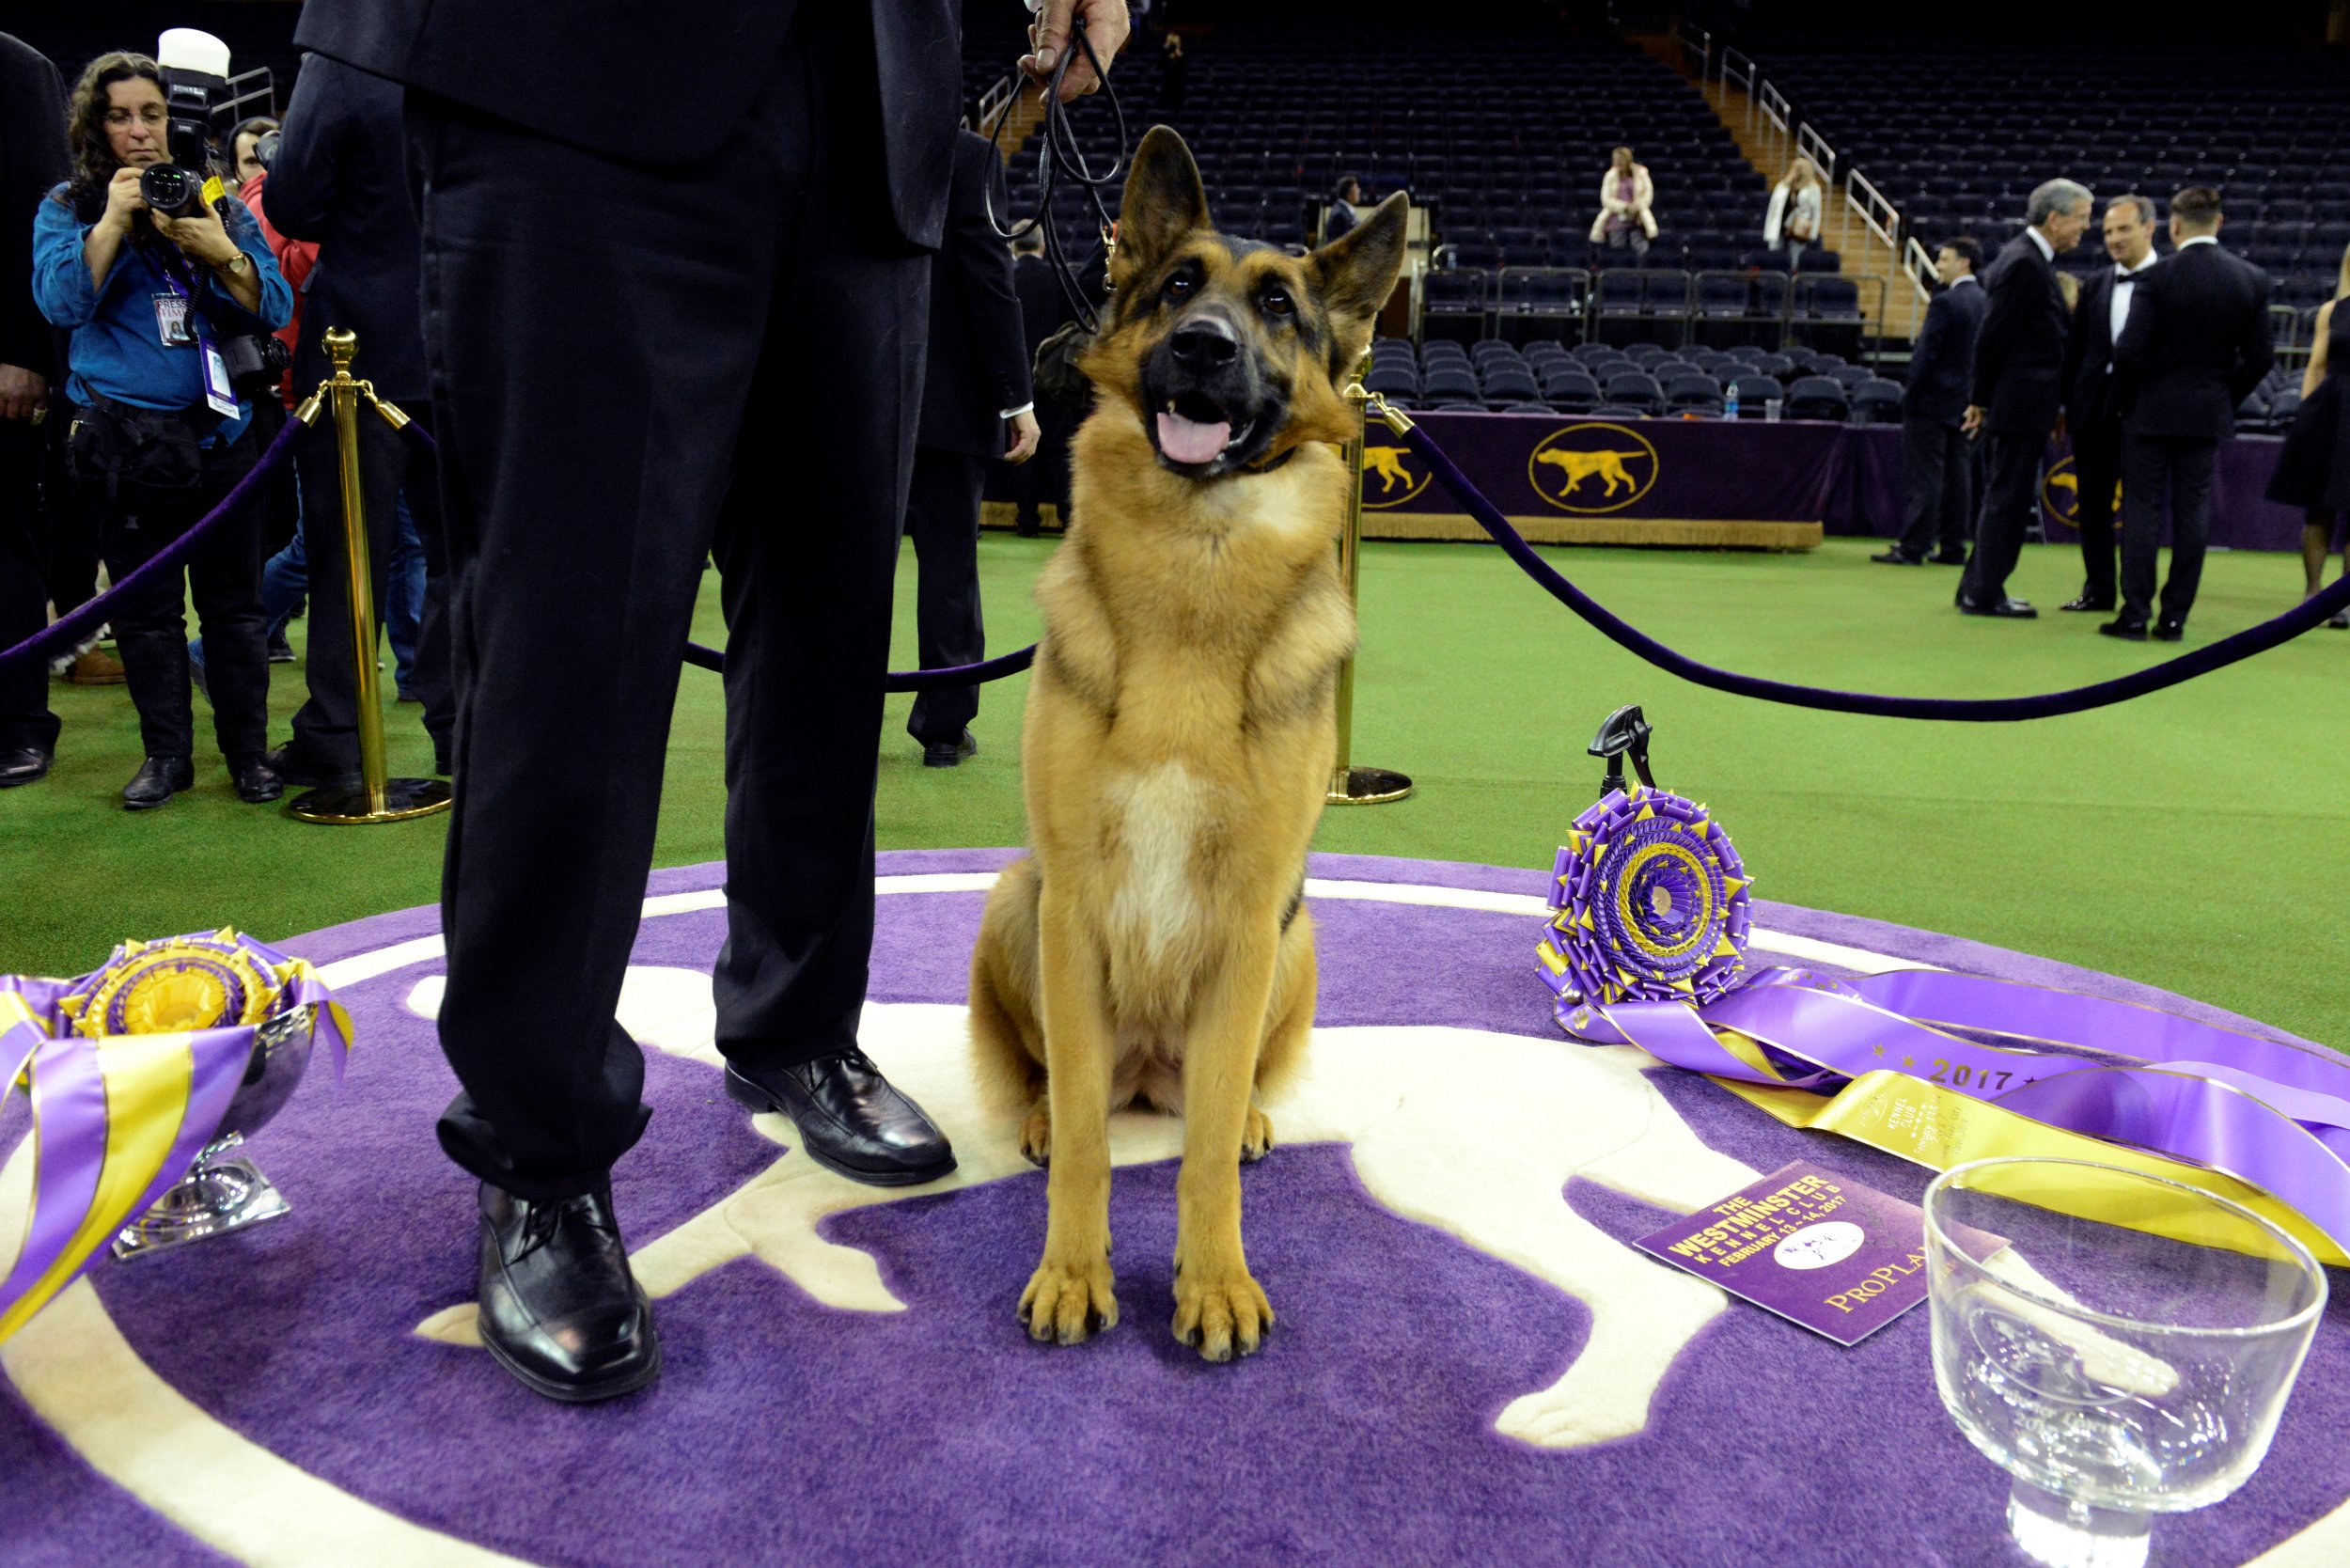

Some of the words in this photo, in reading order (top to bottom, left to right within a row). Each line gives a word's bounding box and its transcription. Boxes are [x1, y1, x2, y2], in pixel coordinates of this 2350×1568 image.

[158, 300, 187, 308] PRESS
[1929, 1058, 2013, 1090] 2017
[1888, 1098, 1907, 1129] KENNEL
[1900, 1105, 1916, 1128] CLUB
[1913, 1125, 1933, 1154] February
[1668, 1174, 1829, 1258] WESTMINSTER
[1712, 1196, 1753, 1216] THE
[1693, 1215, 1785, 1264] KENNEL
[1786, 1184, 1841, 1216] CLUB
[1717, 1231, 1782, 1267] FEBRUARY
[1778, 1224, 1797, 1235] 13
